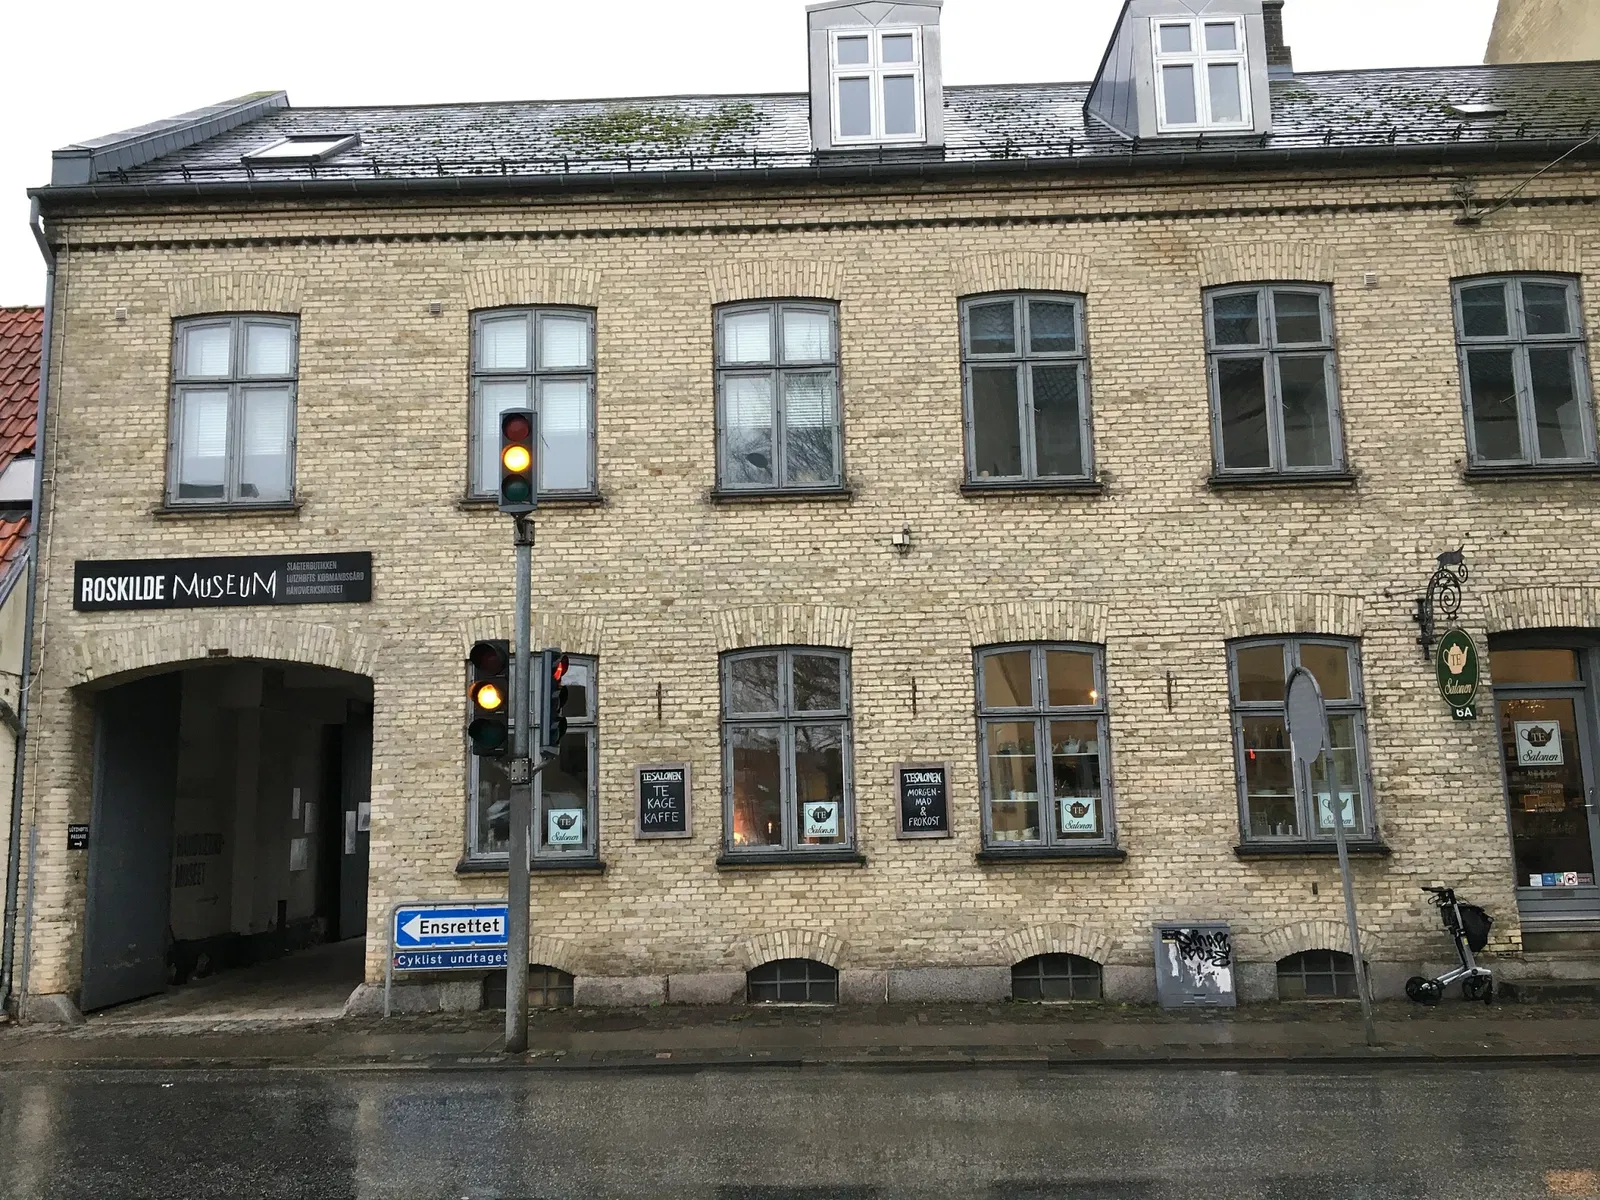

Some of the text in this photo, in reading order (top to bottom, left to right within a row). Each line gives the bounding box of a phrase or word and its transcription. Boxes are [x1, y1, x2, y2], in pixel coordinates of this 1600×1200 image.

[81, 570, 277, 602] ROSKILDE MUSEUM
[1450, 653, 1462, 666] TE
[1444, 677, 1473, 695] Salonen
[1455, 706, 1473, 717] 6A
[1530, 732, 1546, 742] TE
[1522, 749, 1559, 762] Salonen
[641, 771, 683, 782] TESALONEN
[903, 772, 942, 783] TESALONEN
[652, 785, 670, 797] TE
[907, 787, 941, 797] MORGEN-
[647, 797, 677, 809] KAGE
[915, 797, 932, 806] MAD
[815, 811, 827, 819] TE
[919, 806, 927, 817] &
[1072, 806, 1085, 815] TE
[560, 818, 571, 826] TE
[644, 811, 679, 824] KAFFE
[1064, 820, 1093, 830] Salonen
[551, 831, 579, 842] Salonen
[420, 919, 500, 935] Ensrettet
[398, 952, 508, 966] Cyklist undtaget
